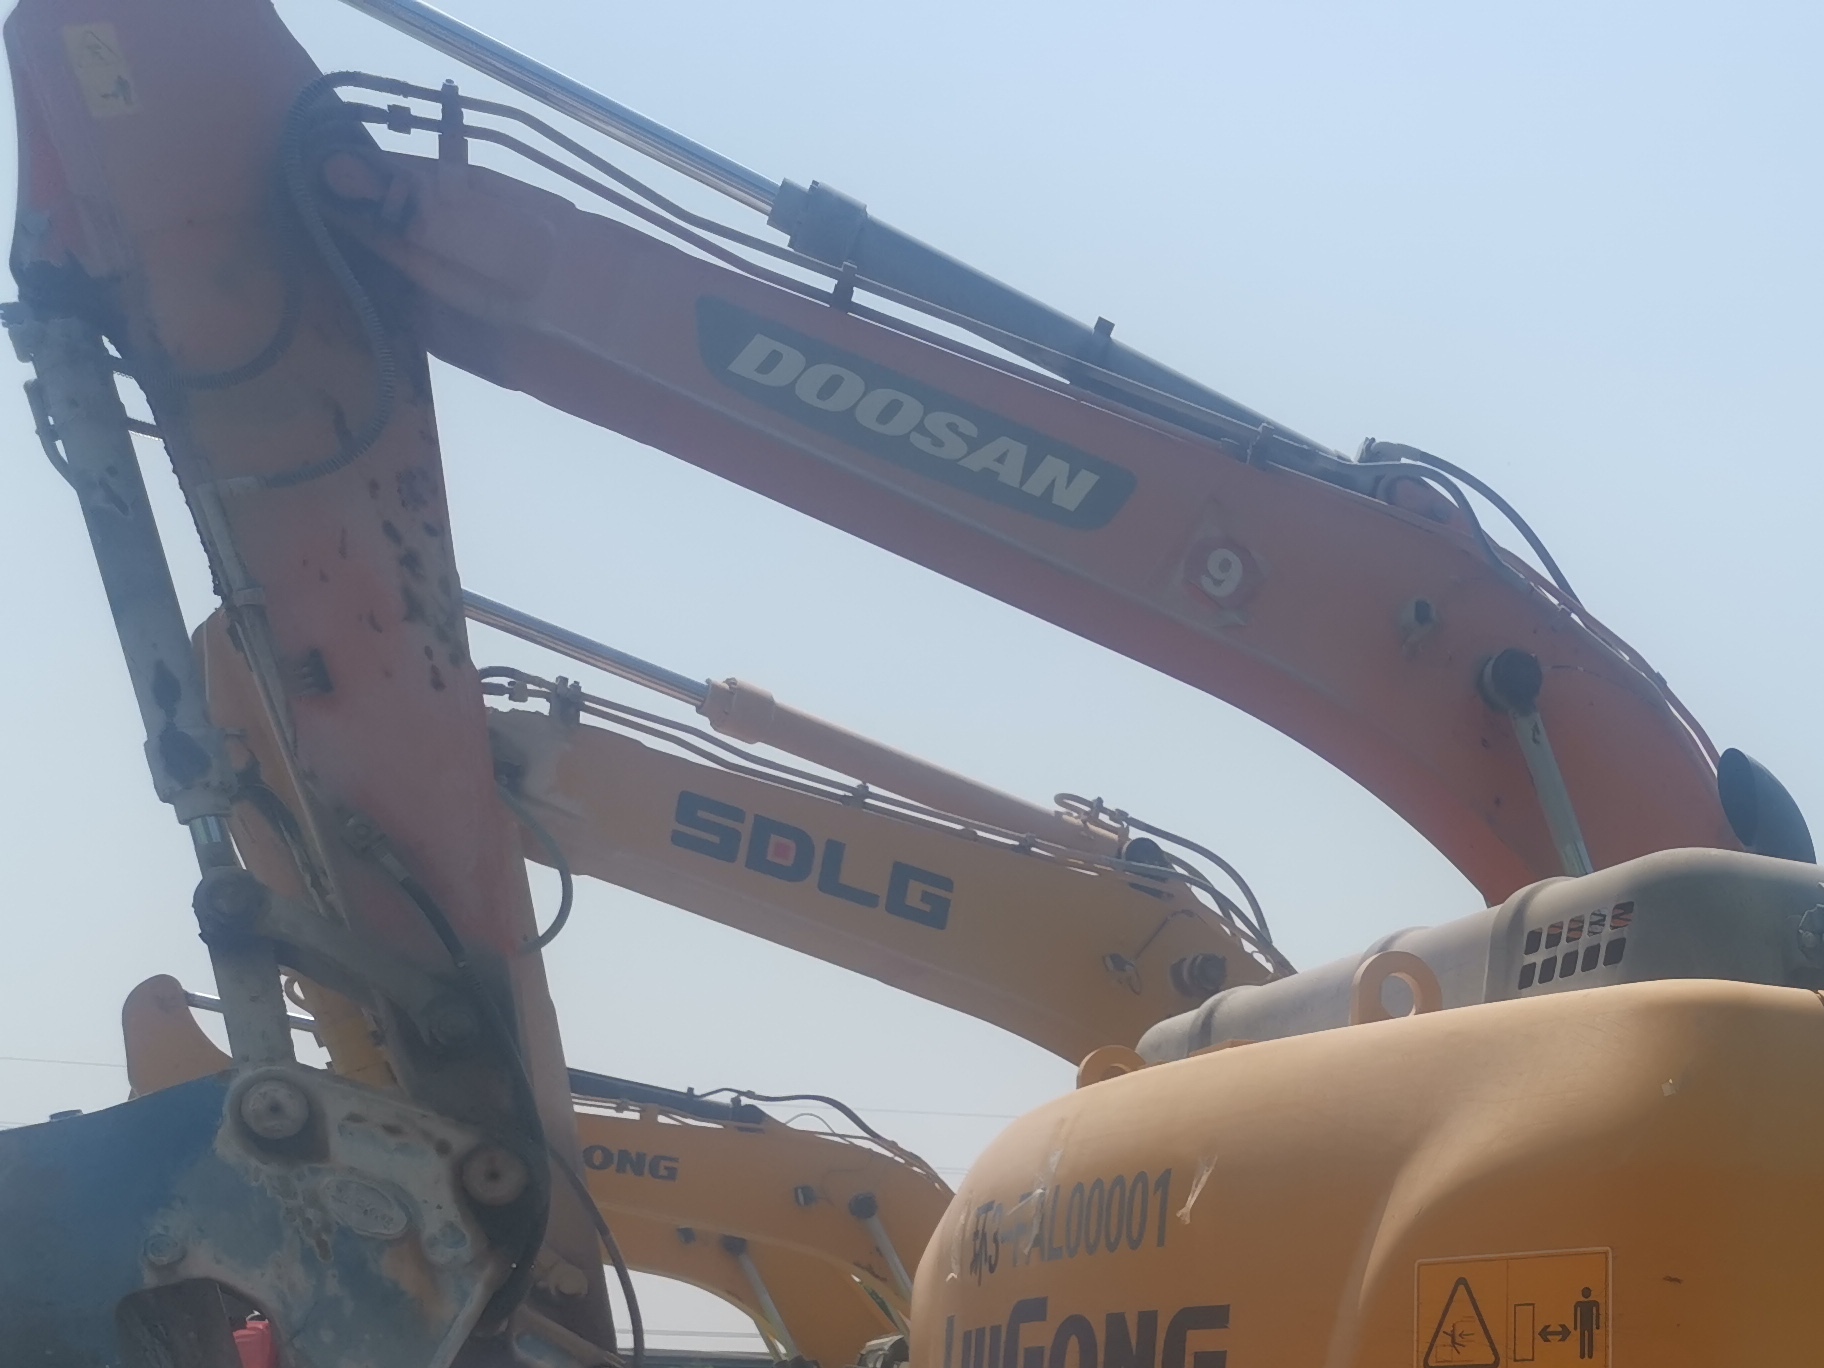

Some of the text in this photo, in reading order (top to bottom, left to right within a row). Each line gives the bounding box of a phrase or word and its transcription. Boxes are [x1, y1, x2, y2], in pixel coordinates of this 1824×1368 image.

[727, 333, 1100, 512] DOOSAN
[1201, 547, 1244, 598] 9
[670, 789, 955, 931] SDLG
